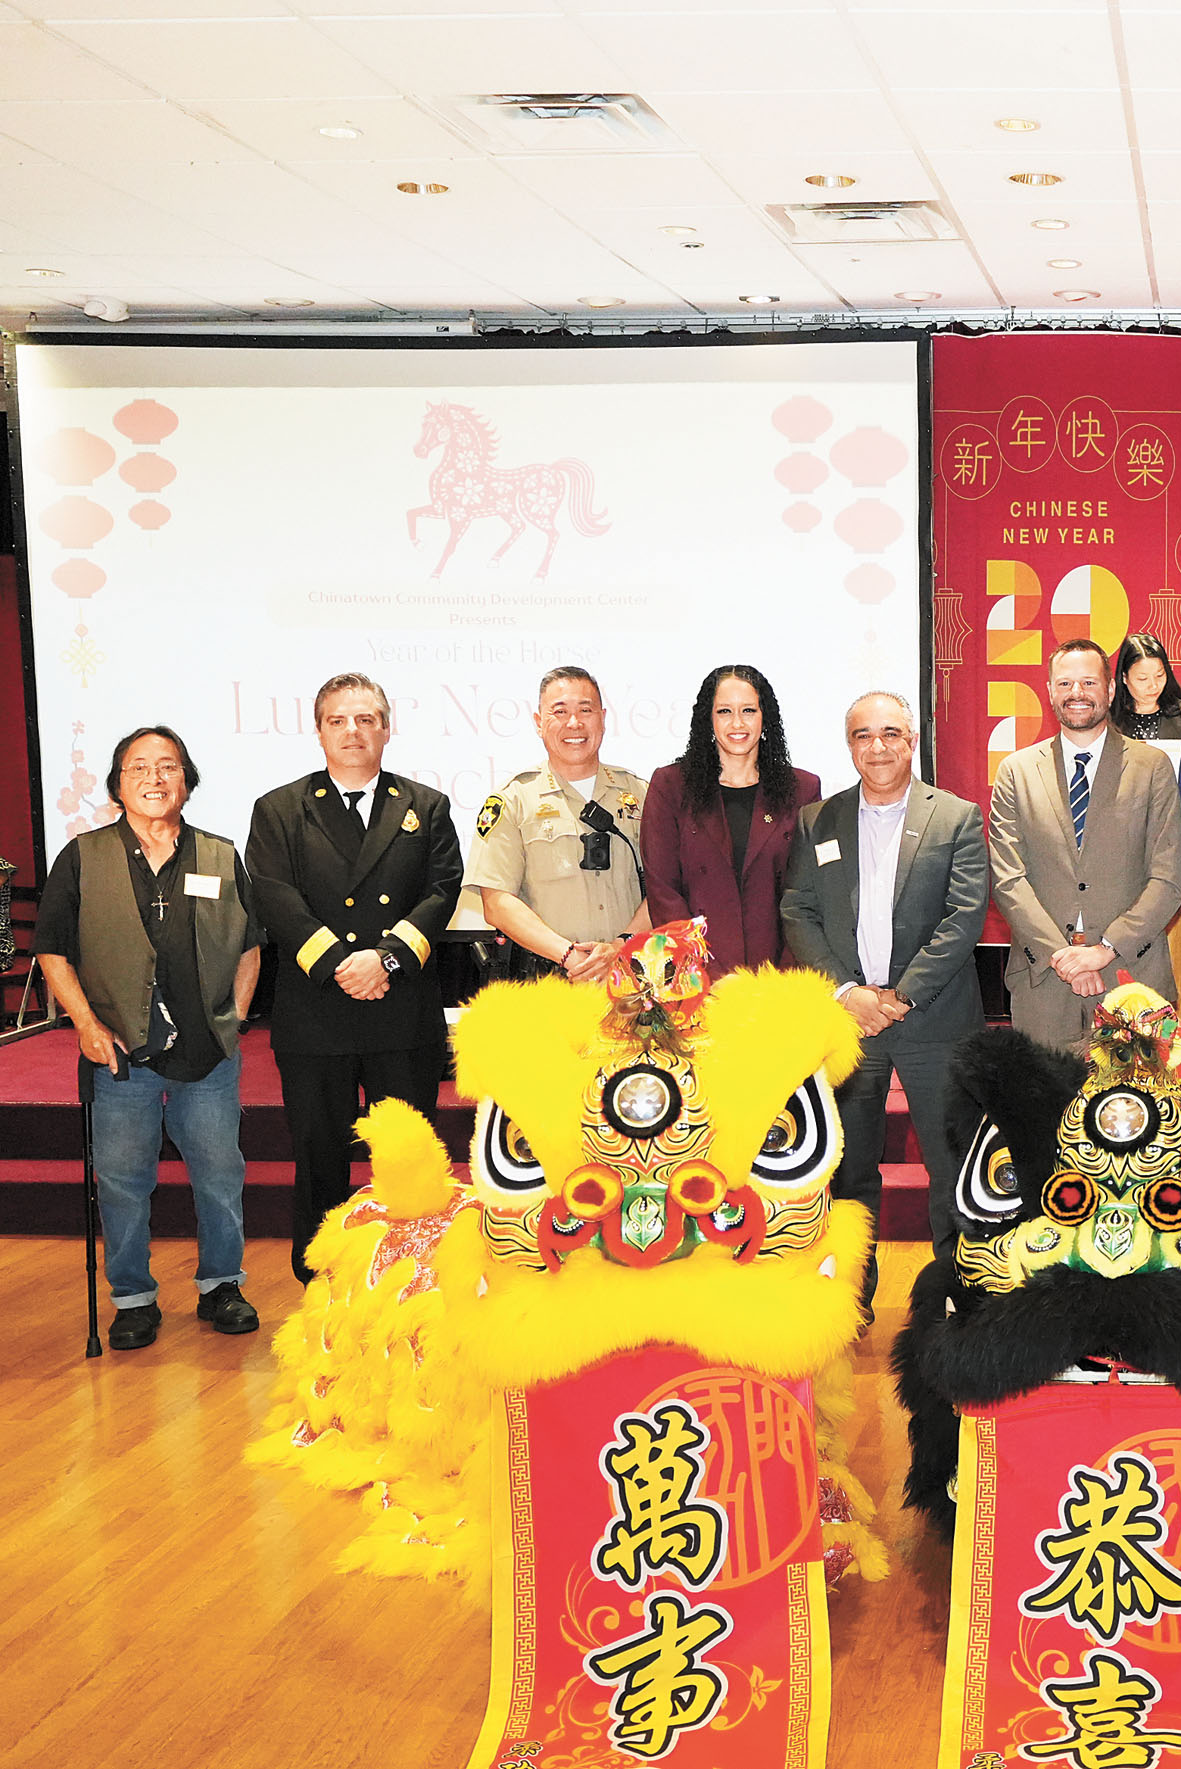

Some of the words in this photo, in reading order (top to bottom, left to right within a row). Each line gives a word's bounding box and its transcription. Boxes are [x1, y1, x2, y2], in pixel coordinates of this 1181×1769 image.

[953, 409, 1164, 486] 新年快樂
[1009, 501, 1109, 517] CHINESE
[1002, 528, 1050, 544] NEW
[1058, 528, 1116, 544] YEAR
[308, 589, 392, 605] Chinatown
[396, 591, 487, 608] Community
[490, 591, 593, 609] Development
[597, 591, 649, 606] Center
[448, 612, 518, 626] Presents
[366, 638, 428, 664] Year
[434, 638, 464, 664] of
[472, 638, 511, 664] the
[520, 638, 601, 664] Horse
[232, 680, 419, 736] Lur
[440, 683, 538, 738] Ne
[600, 681, 697, 738] Yea
